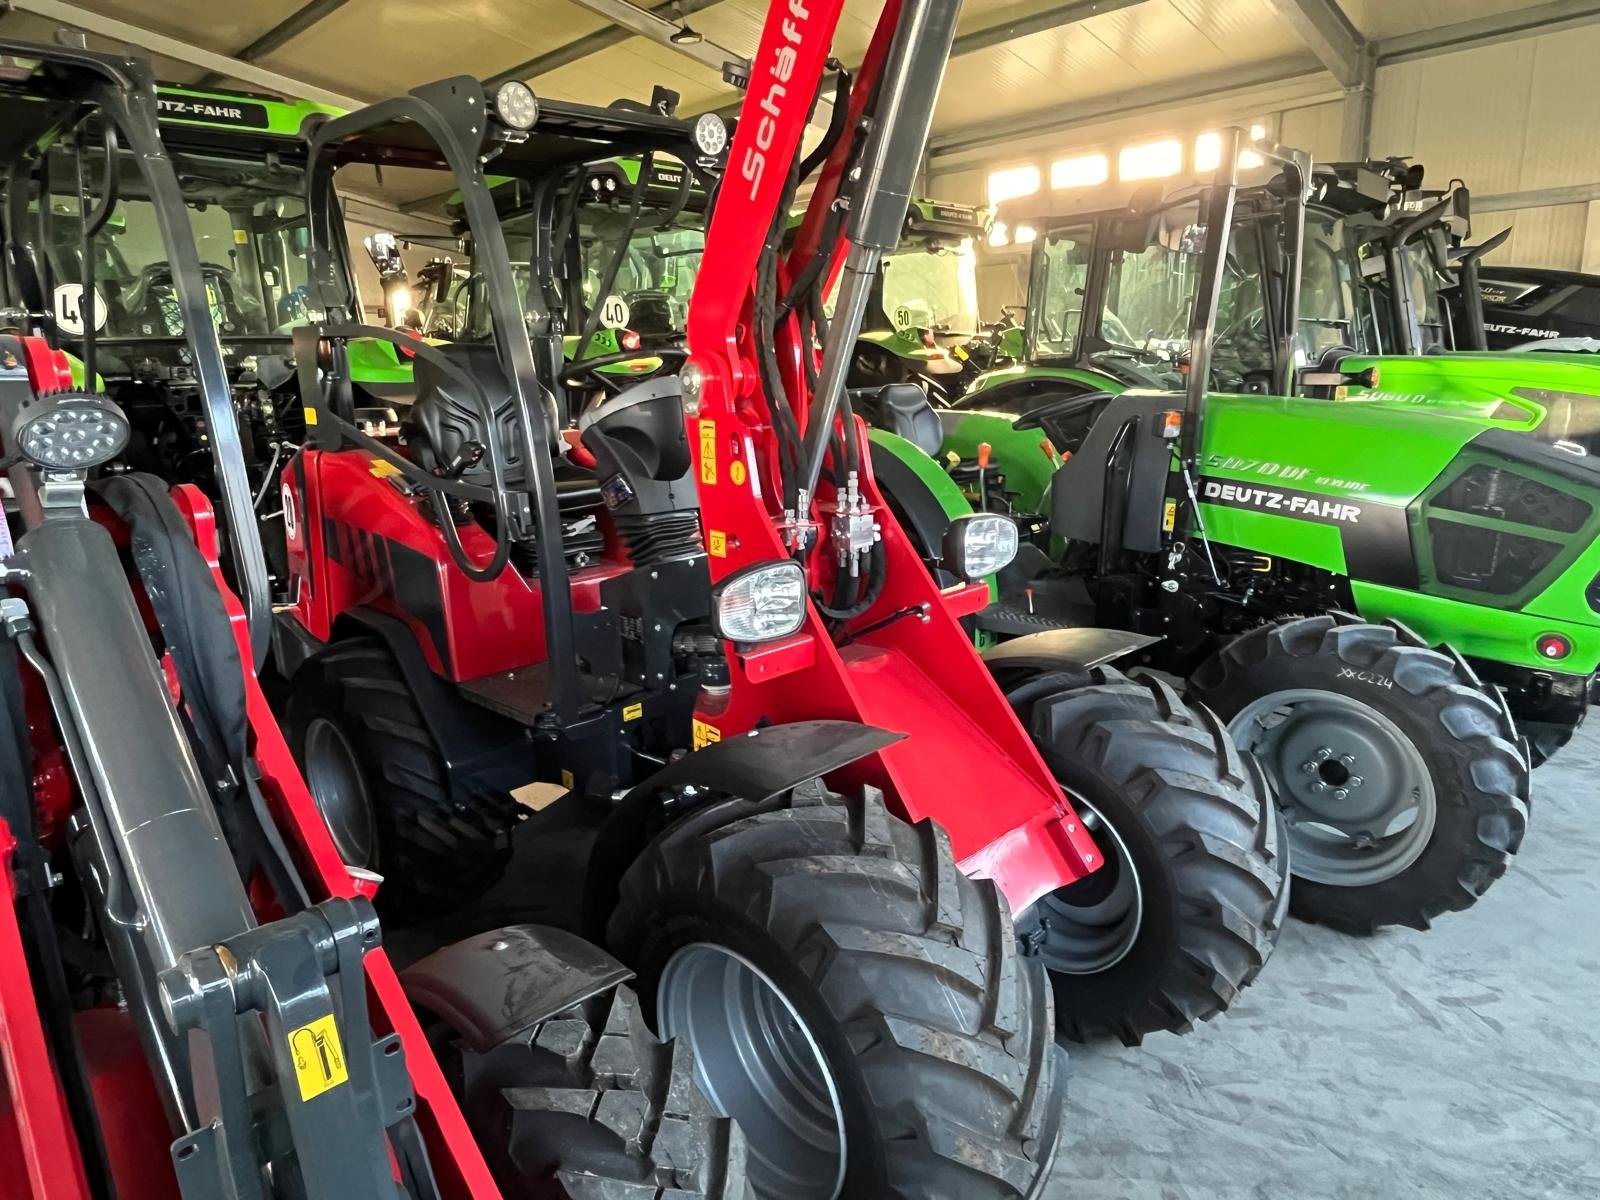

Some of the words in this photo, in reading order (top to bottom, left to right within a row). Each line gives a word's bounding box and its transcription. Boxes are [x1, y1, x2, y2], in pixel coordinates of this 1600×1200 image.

[606, 303, 623, 323] 40
[898, 310, 910, 325] 50
[1483, 323, 1560, 339] EUTZ-FAHR
[1204, 482, 1361, 523] DEUTZ-FAHR
